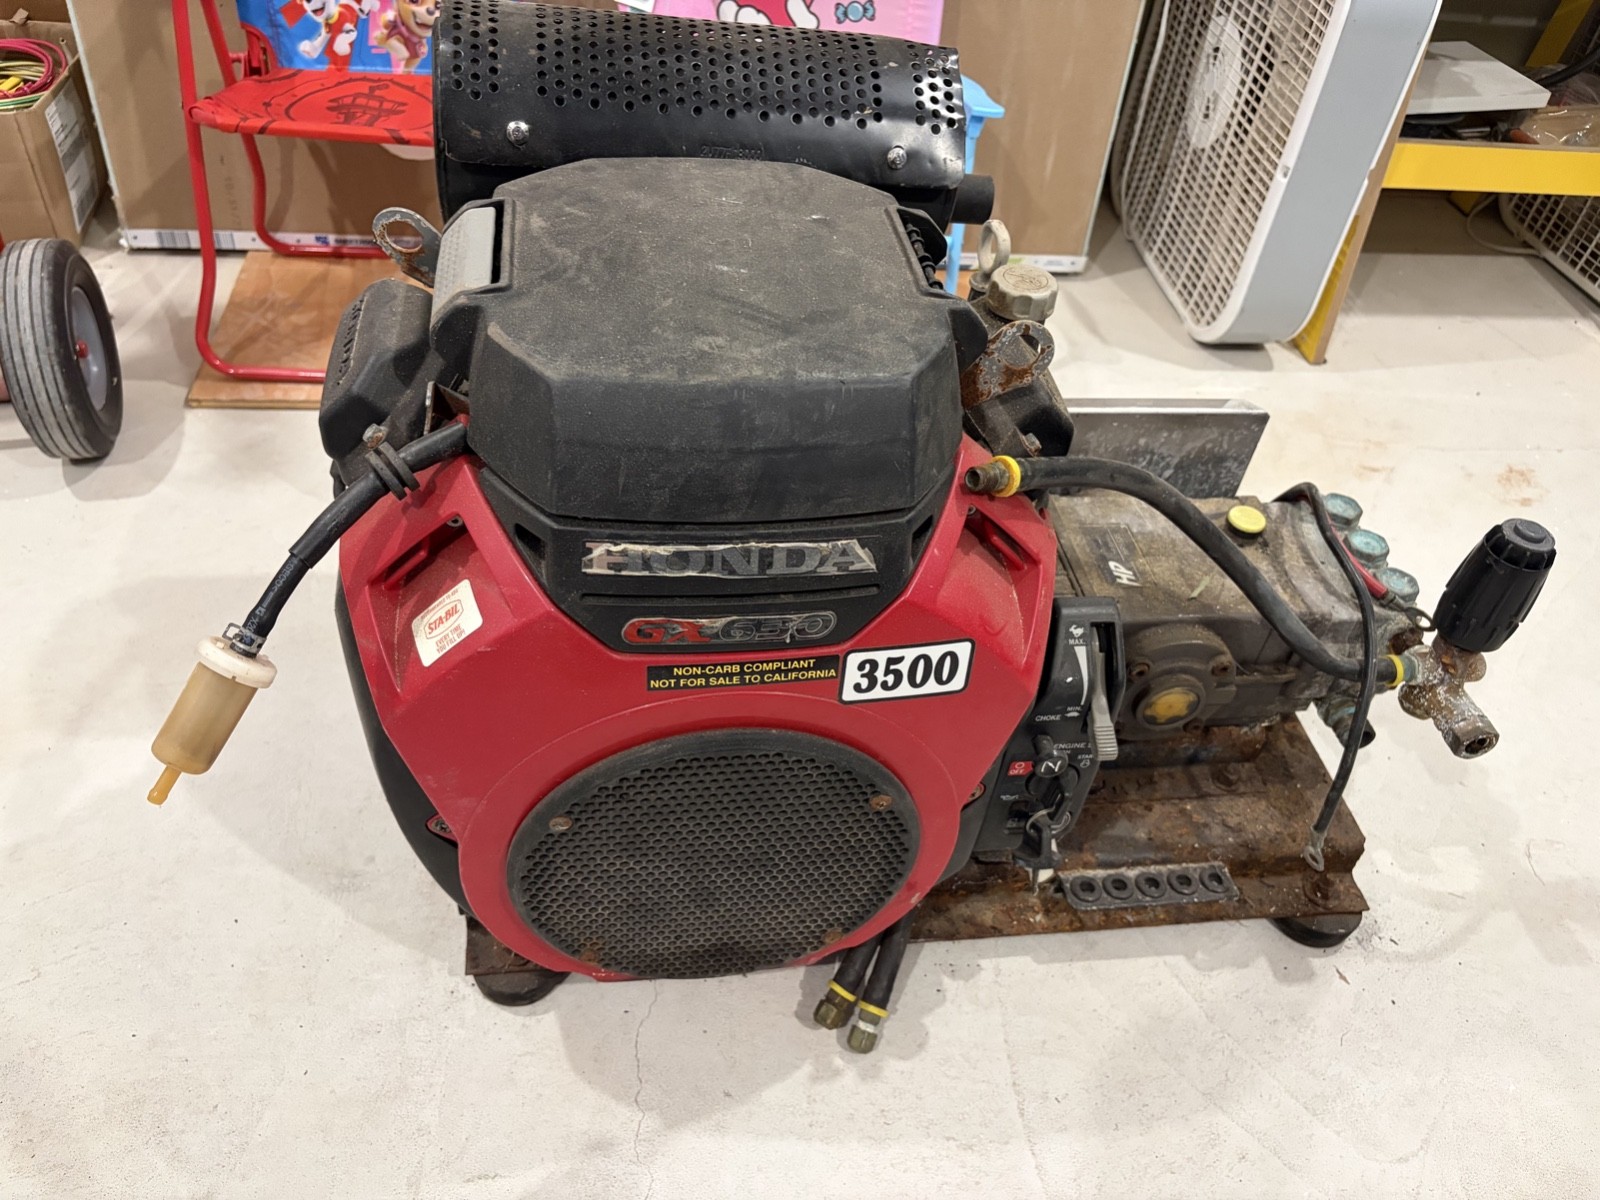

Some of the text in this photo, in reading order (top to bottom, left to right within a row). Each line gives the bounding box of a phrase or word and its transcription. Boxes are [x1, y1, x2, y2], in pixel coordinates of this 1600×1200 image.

[584, 540, 877, 578] HONDA
[428, 604, 460, 635] STA-BIL
[435, 623, 462, 648] EVERY TIME
[436, 642, 447, 654] YOU
[446, 634, 457, 648] FILL
[1068, 638, 1086, 646] MAX.
[673, 658, 817, 676] NON-CARB COMPLIANT
[853, 650, 960, 694] 3500
[650, 669, 837, 689] NOT FOR SALE TO CALIFORNIA
[1035, 714, 1062, 722] CHOKE
[1053, 742, 1086, 750] ENGINE
